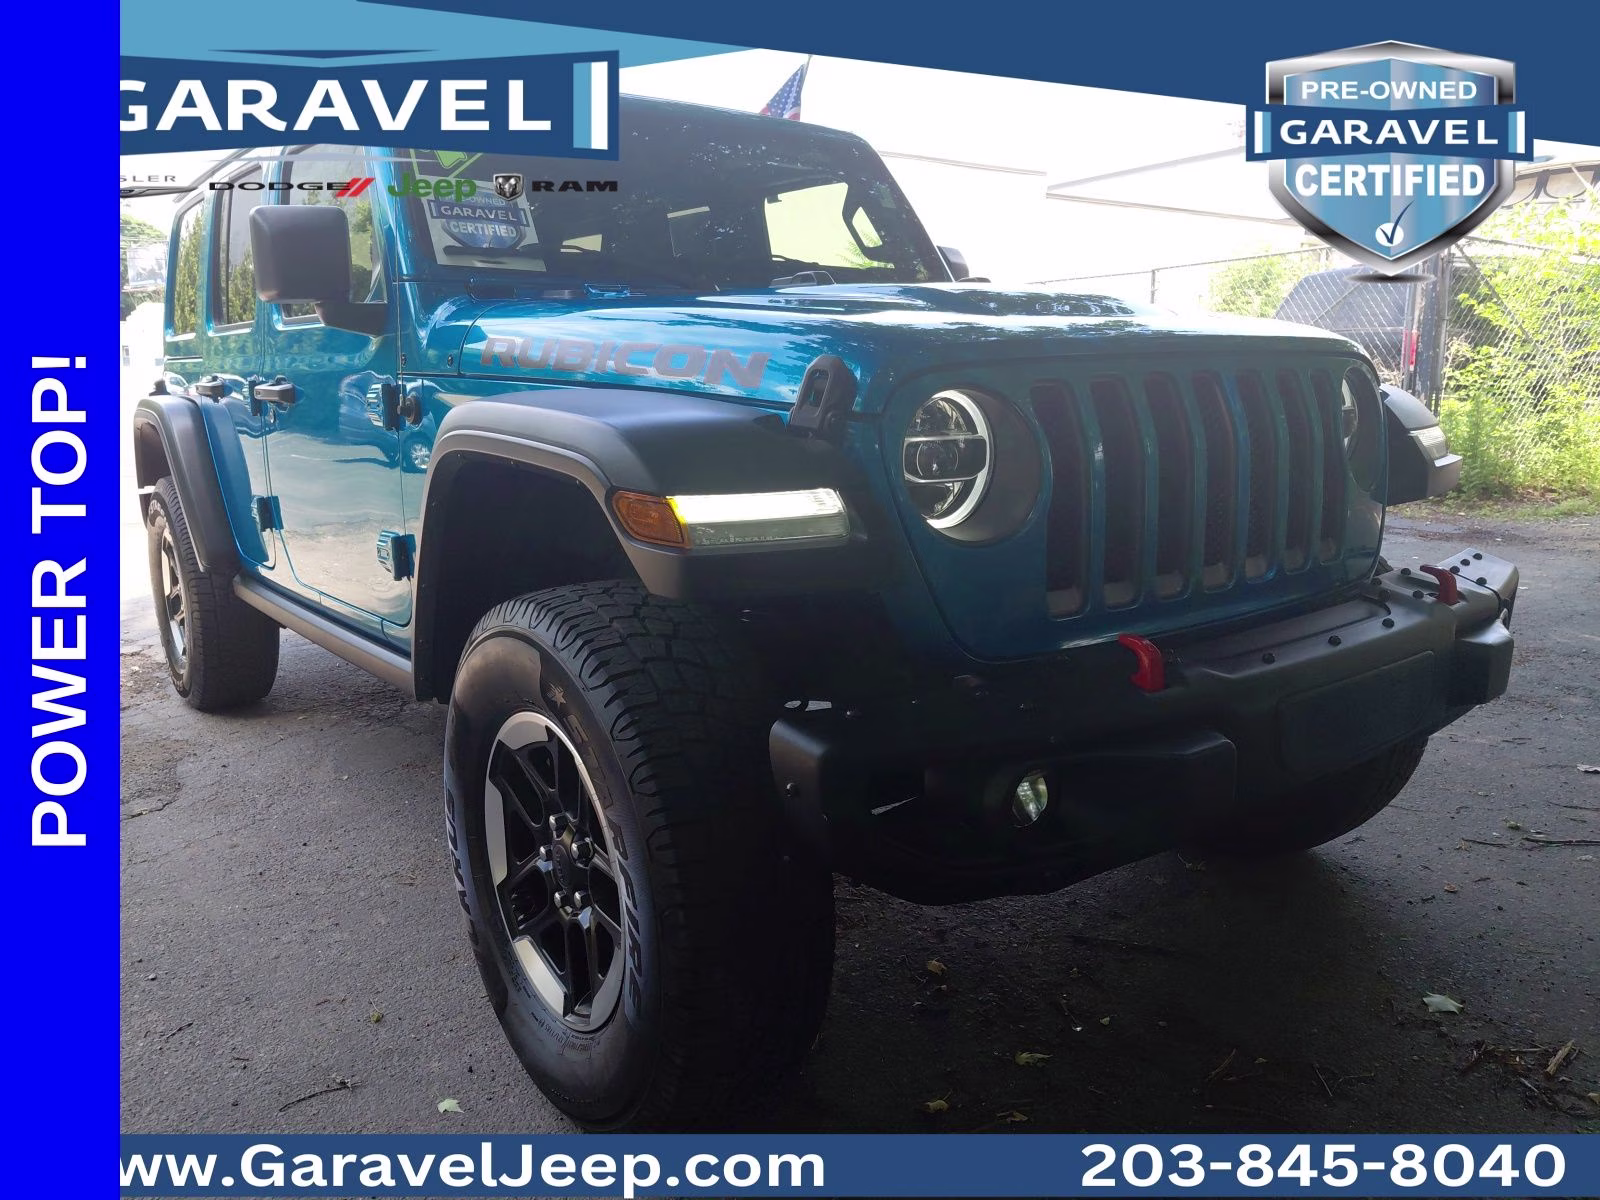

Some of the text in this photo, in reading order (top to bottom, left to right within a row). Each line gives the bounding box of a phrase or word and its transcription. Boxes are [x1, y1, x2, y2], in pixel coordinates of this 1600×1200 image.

[441, 206, 517, 221] GARAVEL
[449, 221, 517, 238] CERTIFIED
[480, 336, 771, 389] RUBICON
